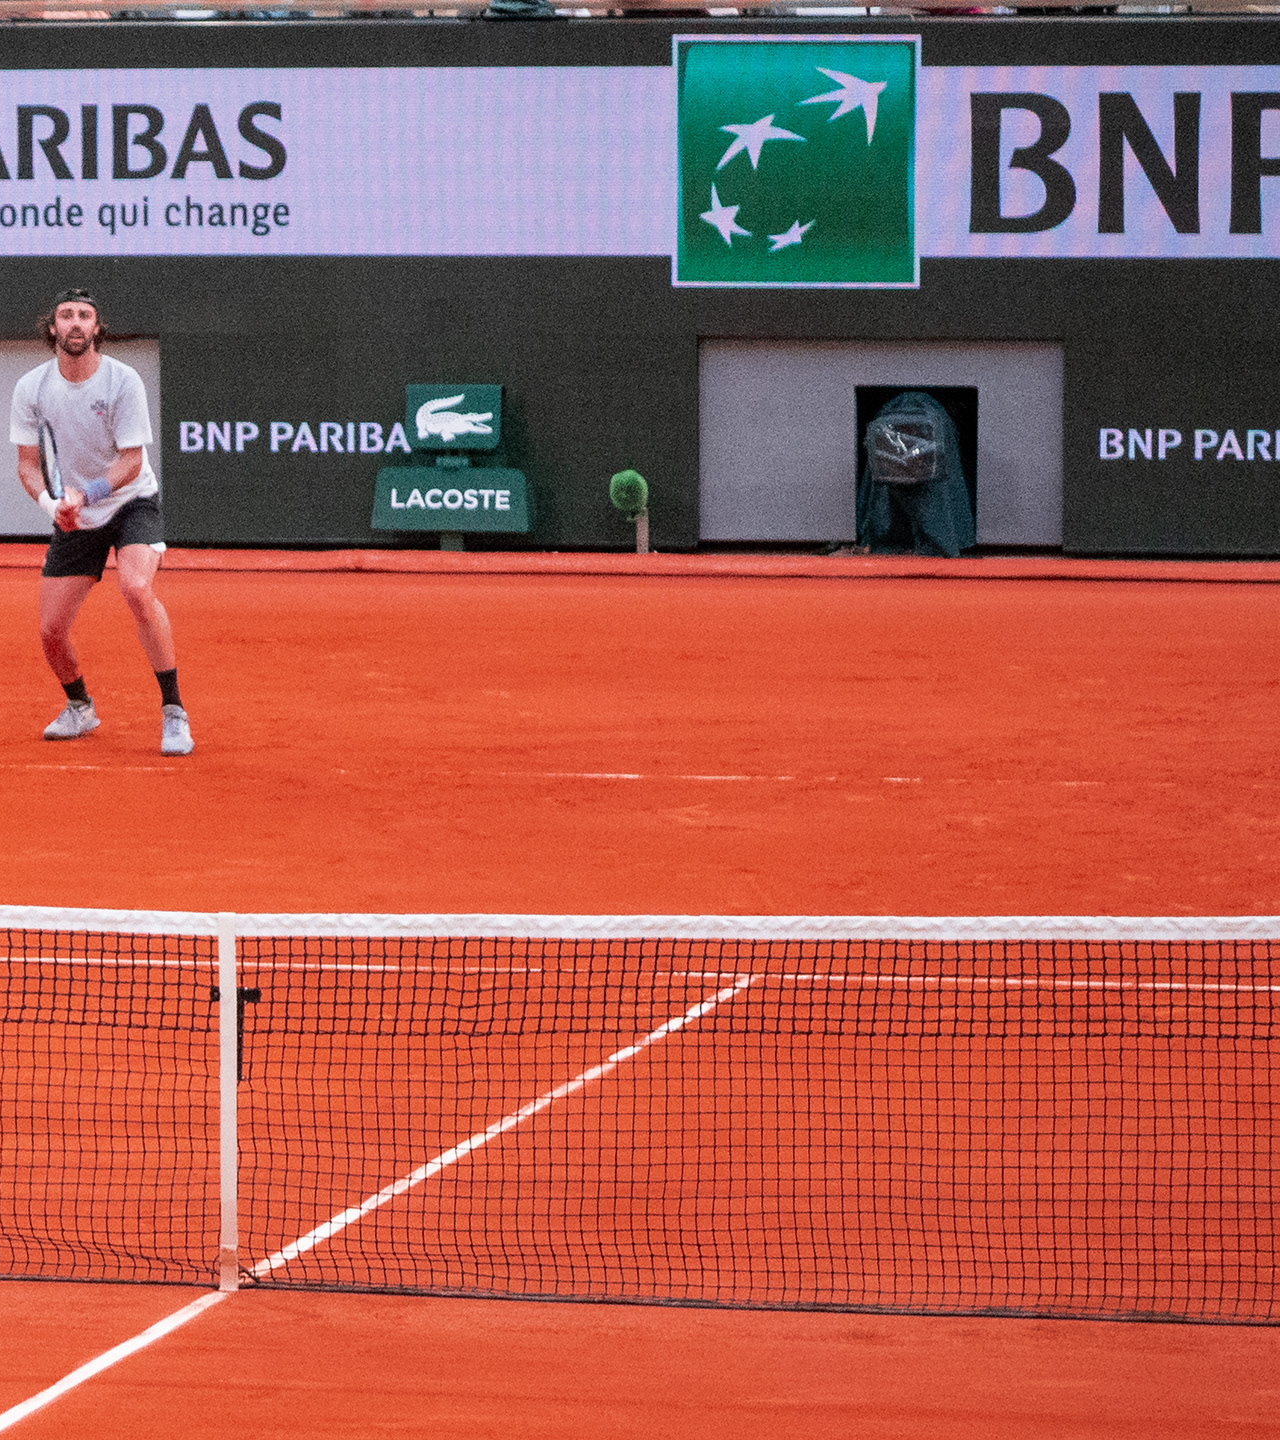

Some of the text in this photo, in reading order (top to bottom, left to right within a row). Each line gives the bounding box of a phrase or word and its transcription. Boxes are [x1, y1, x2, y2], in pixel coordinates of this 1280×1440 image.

[98, 196, 148, 235] qui
[165, 196, 289, 236] change
[180, 422, 259, 451] BNP
[1100, 429, 1182, 459] BNP
[391, 489, 510, 510] LACOSTE
